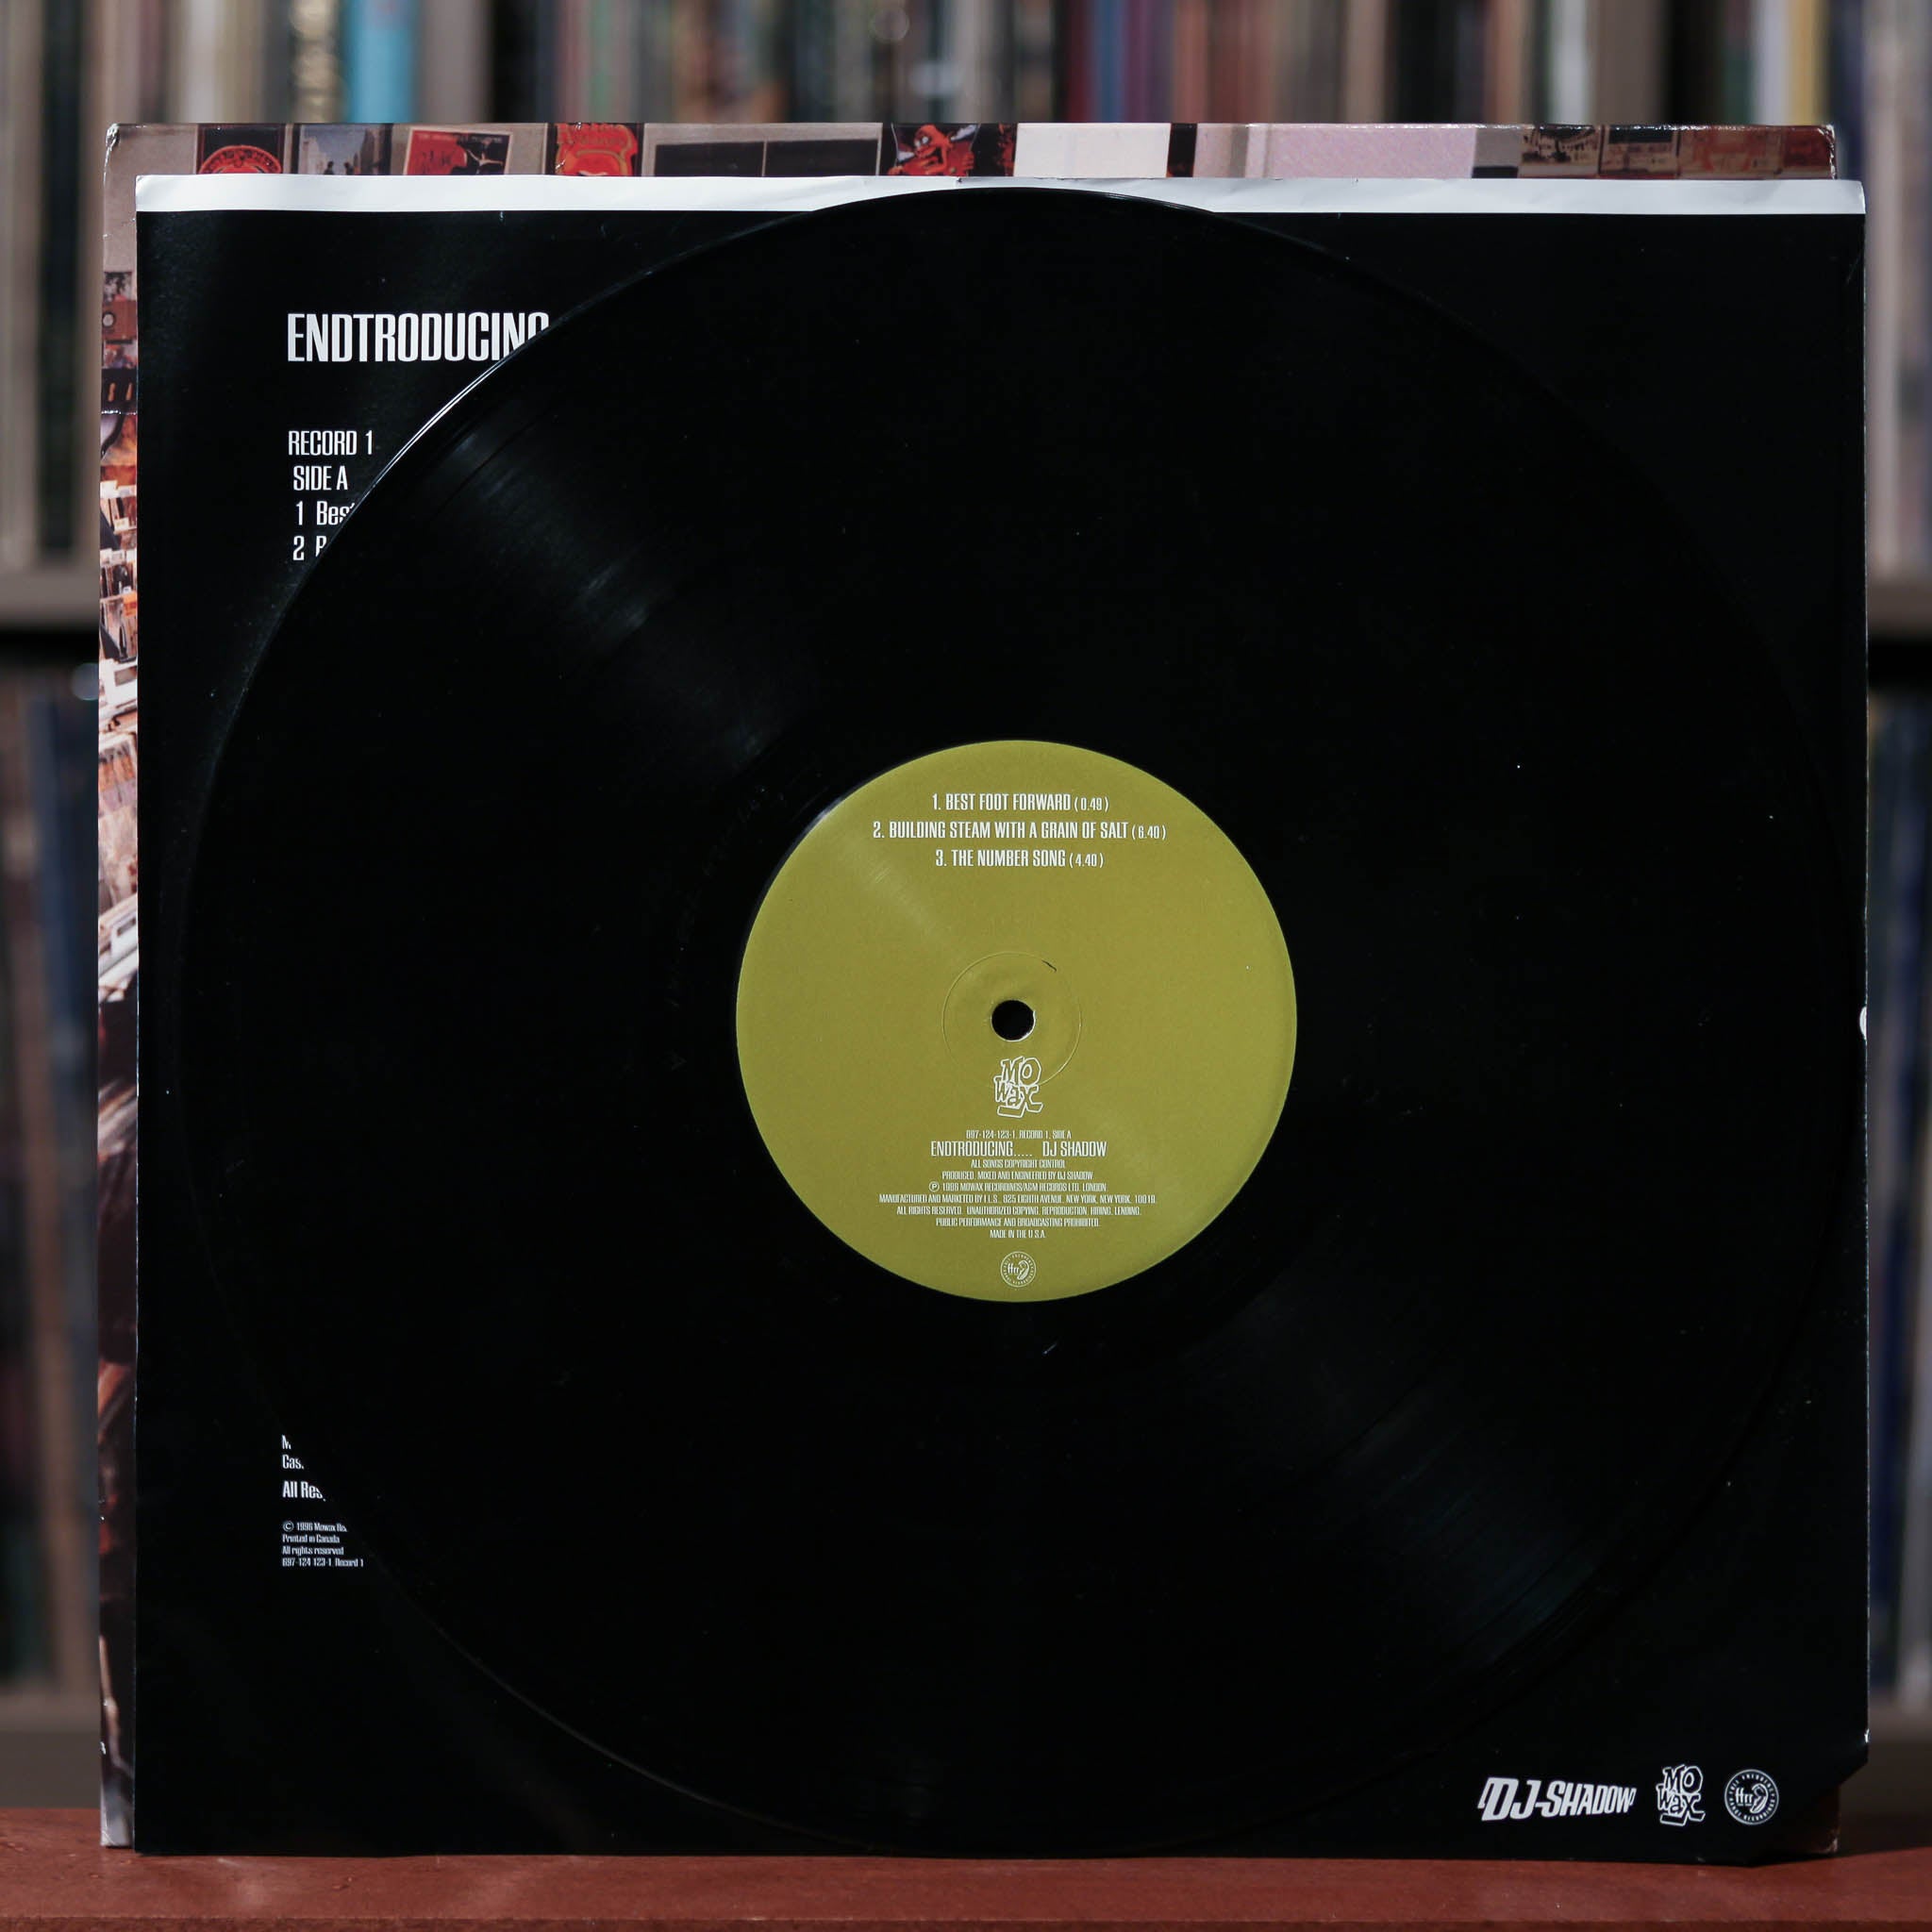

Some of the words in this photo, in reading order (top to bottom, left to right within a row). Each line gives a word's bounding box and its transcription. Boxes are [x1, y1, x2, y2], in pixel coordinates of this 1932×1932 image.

[288, 430, 358, 456] RECORD
[365, 430, 373, 455] 1
[292, 466, 332, 491] SIDE
[336, 466, 348, 491] A
[295, 501, 304, 525] 1
[316, 501, 355, 525] Bes
[292, 536, 305, 560] 2
[932, 793, 941, 811] 1.
[945, 793, 975, 811] BEST
[979, 793, 1009, 811] FOOT
[1012, 793, 1071, 811] FORWARD
[873, 822, 885, 840] 2.
[889, 822, 946, 840] BUILDING
[949, 822, 991, 840] STEAM
[994, 822, 1025, 840] WITH
[1029, 822, 1038, 840] A
[1041, 822, 1078, 840] GRAIN
[1082, 822, 1096, 840] OF
[1100, 822, 1128, 840] SALT
[935, 849, 947, 867] 3.
[951, 849, 974, 867] THE
[977, 849, 1029, 867] NUMBER
[1033, 849, 1066, 867] SONG
[1019, 1130, 1043, 1139] RECORD
[1066, 1130, 1072, 1139] A
[1042, 1141, 1058, 1158] DJ
[1060, 1141, 1108, 1158] SHADOW
[971, 1159, 981, 1169] ALL
[983, 1159, 1004, 1169] SONGS
[1005, 1159, 1038, 1169] COPYRIGHT
[977, 1171, 997, 1180] MIXED
[997, 1171, 1010, 1180] AND
[1011, 1171, 1047, 1180] ENGINEERED
[1048, 1171, 1057, 1180] BY
[1058, 1171, 1066, 1180] DJ
[960, 1183, 984, 1192] MOWAX
[1040, 1183, 1067, 1192] RECORDS
[879, 1194, 927, 1204] MANUFACTURED
[928, 1194, 941, 1204] AND
[942, 1194, 974, 1204] MARKETED
[974, 1194, 983, 1204] BY
[1018, 1194, 1039, 1204] EIGHTH
[1066, 1194, 1080, 1204] NEW
[1099, 1194, 1113, 1204] NEW
[897, 1206, 907, 1215] ALL
[908, 1206, 930, 1215] RIGHTS
[967, 1206, 1011, 1215] UNAUTHORIZED
[936, 1218, 958, 1227] PUBLIC
[958, 1218, 1002, 1227] PERFORMANCE
[1004, 1218, 1016, 1227] AND
[1018, 1218, 1062, 1227] BROADCASTING
[990, 1229, 1006, 1239] MADE
[1008, 1229, 1015, 1239] IN
[1017, 1229, 1026, 1239] THE
[282, 1480, 297, 1498] All
[300, 1480, 326, 1502] Res
[314, 1522, 337, 1532] Mowax
[282, 1534, 308, 1543] Printed
[308, 1534, 316, 1543] in
[316, 1534, 341, 1543] Canada
[282, 1545, 291, 1556] All
[291, 1546, 313, 1557] rights
[314, 1546, 344, 1556] reserved
[335, 1557, 358, 1568] Record
